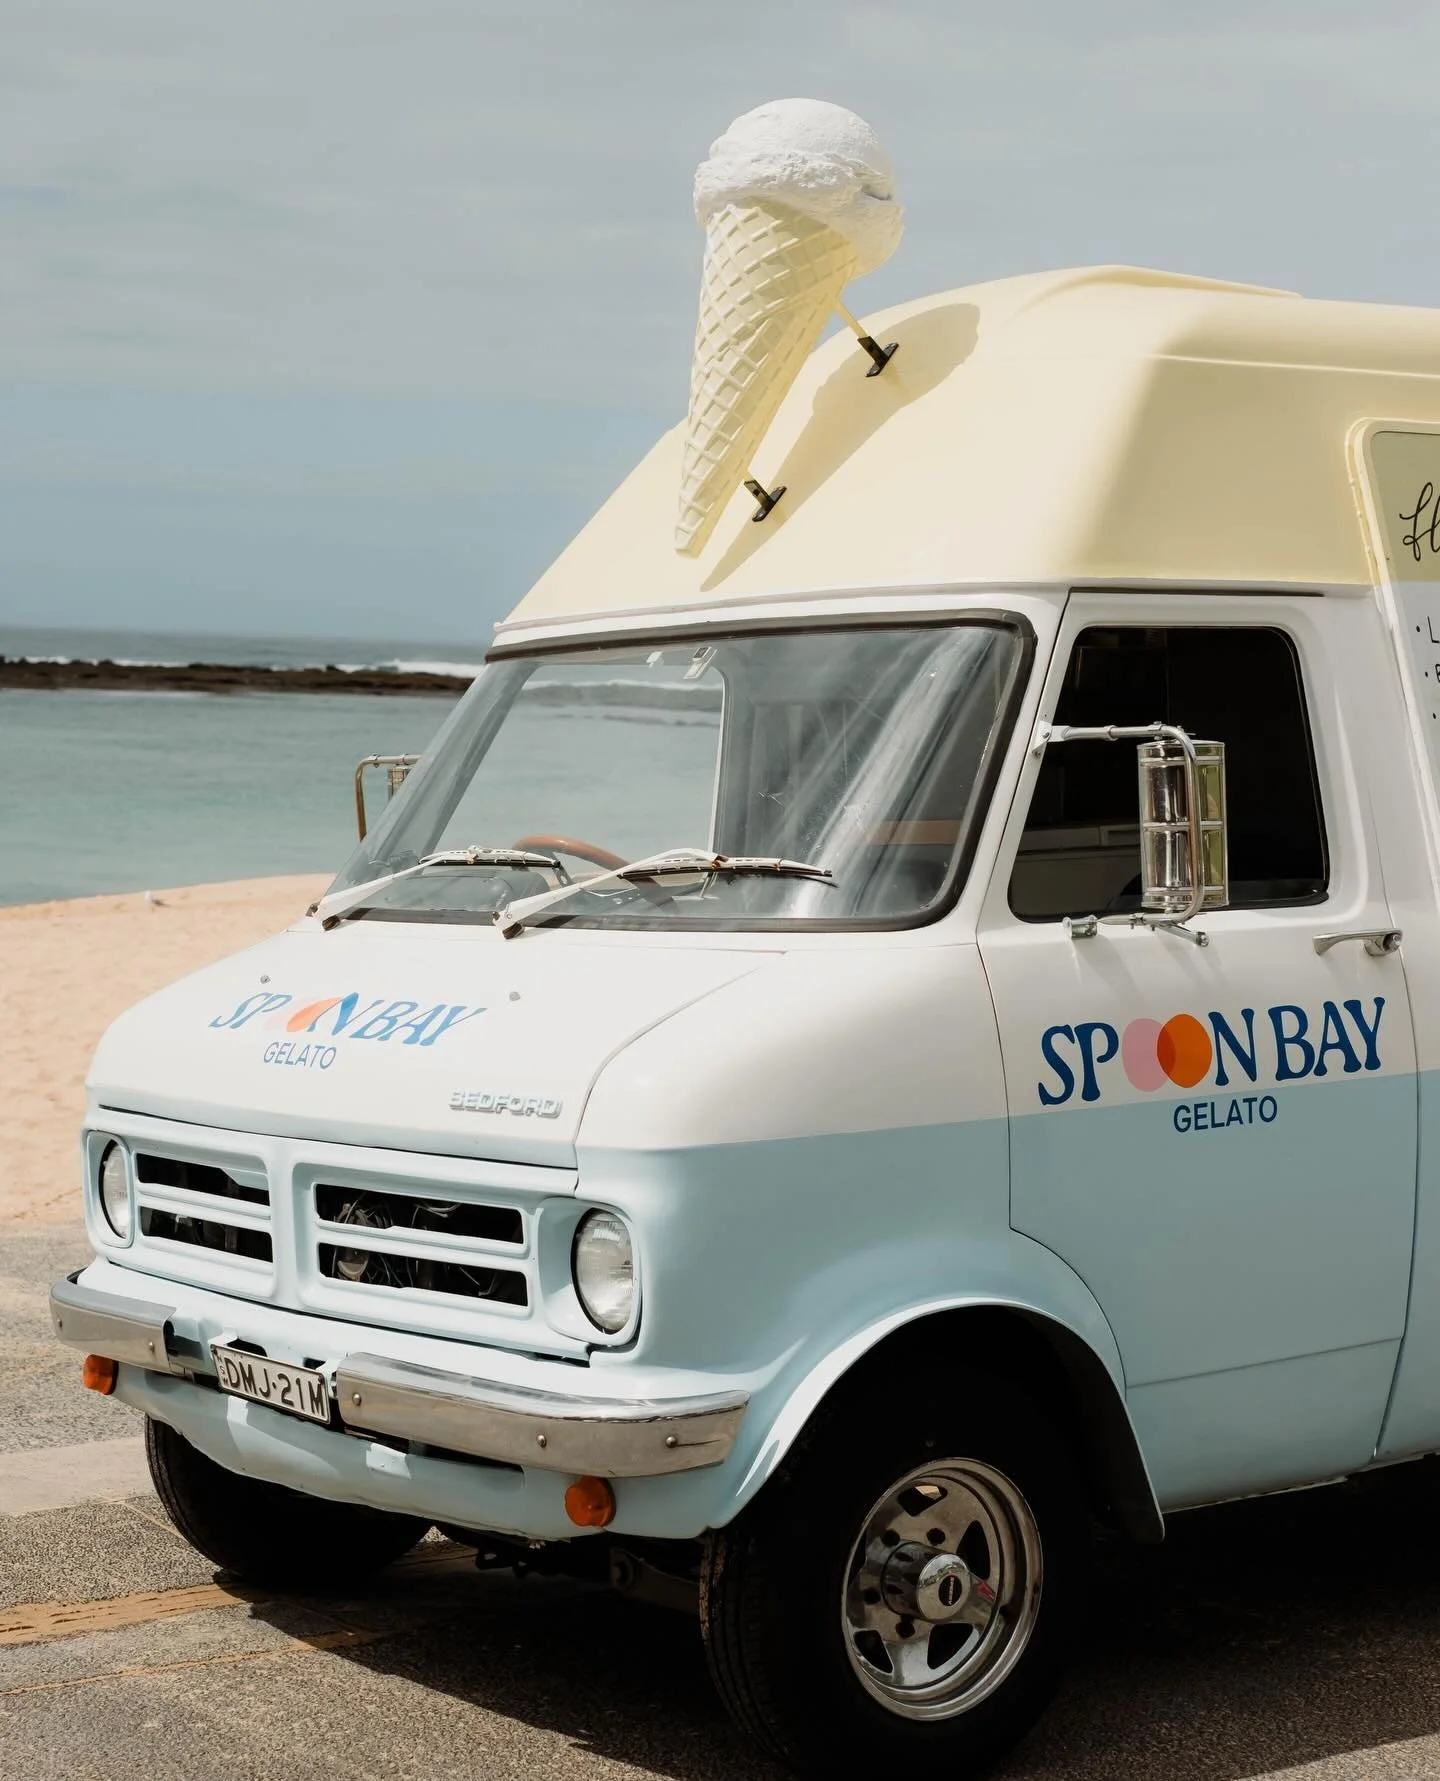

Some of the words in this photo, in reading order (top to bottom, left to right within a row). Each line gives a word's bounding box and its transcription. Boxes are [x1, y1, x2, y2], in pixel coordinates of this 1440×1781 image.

[349, 999, 487, 1047] BAY
[1268, 997, 1385, 1081] BAY
[262, 1041, 337, 1069] GELATO
[449, 1091, 562, 1119] BEDFORD
[1173, 1095, 1278, 1132] GELATO
